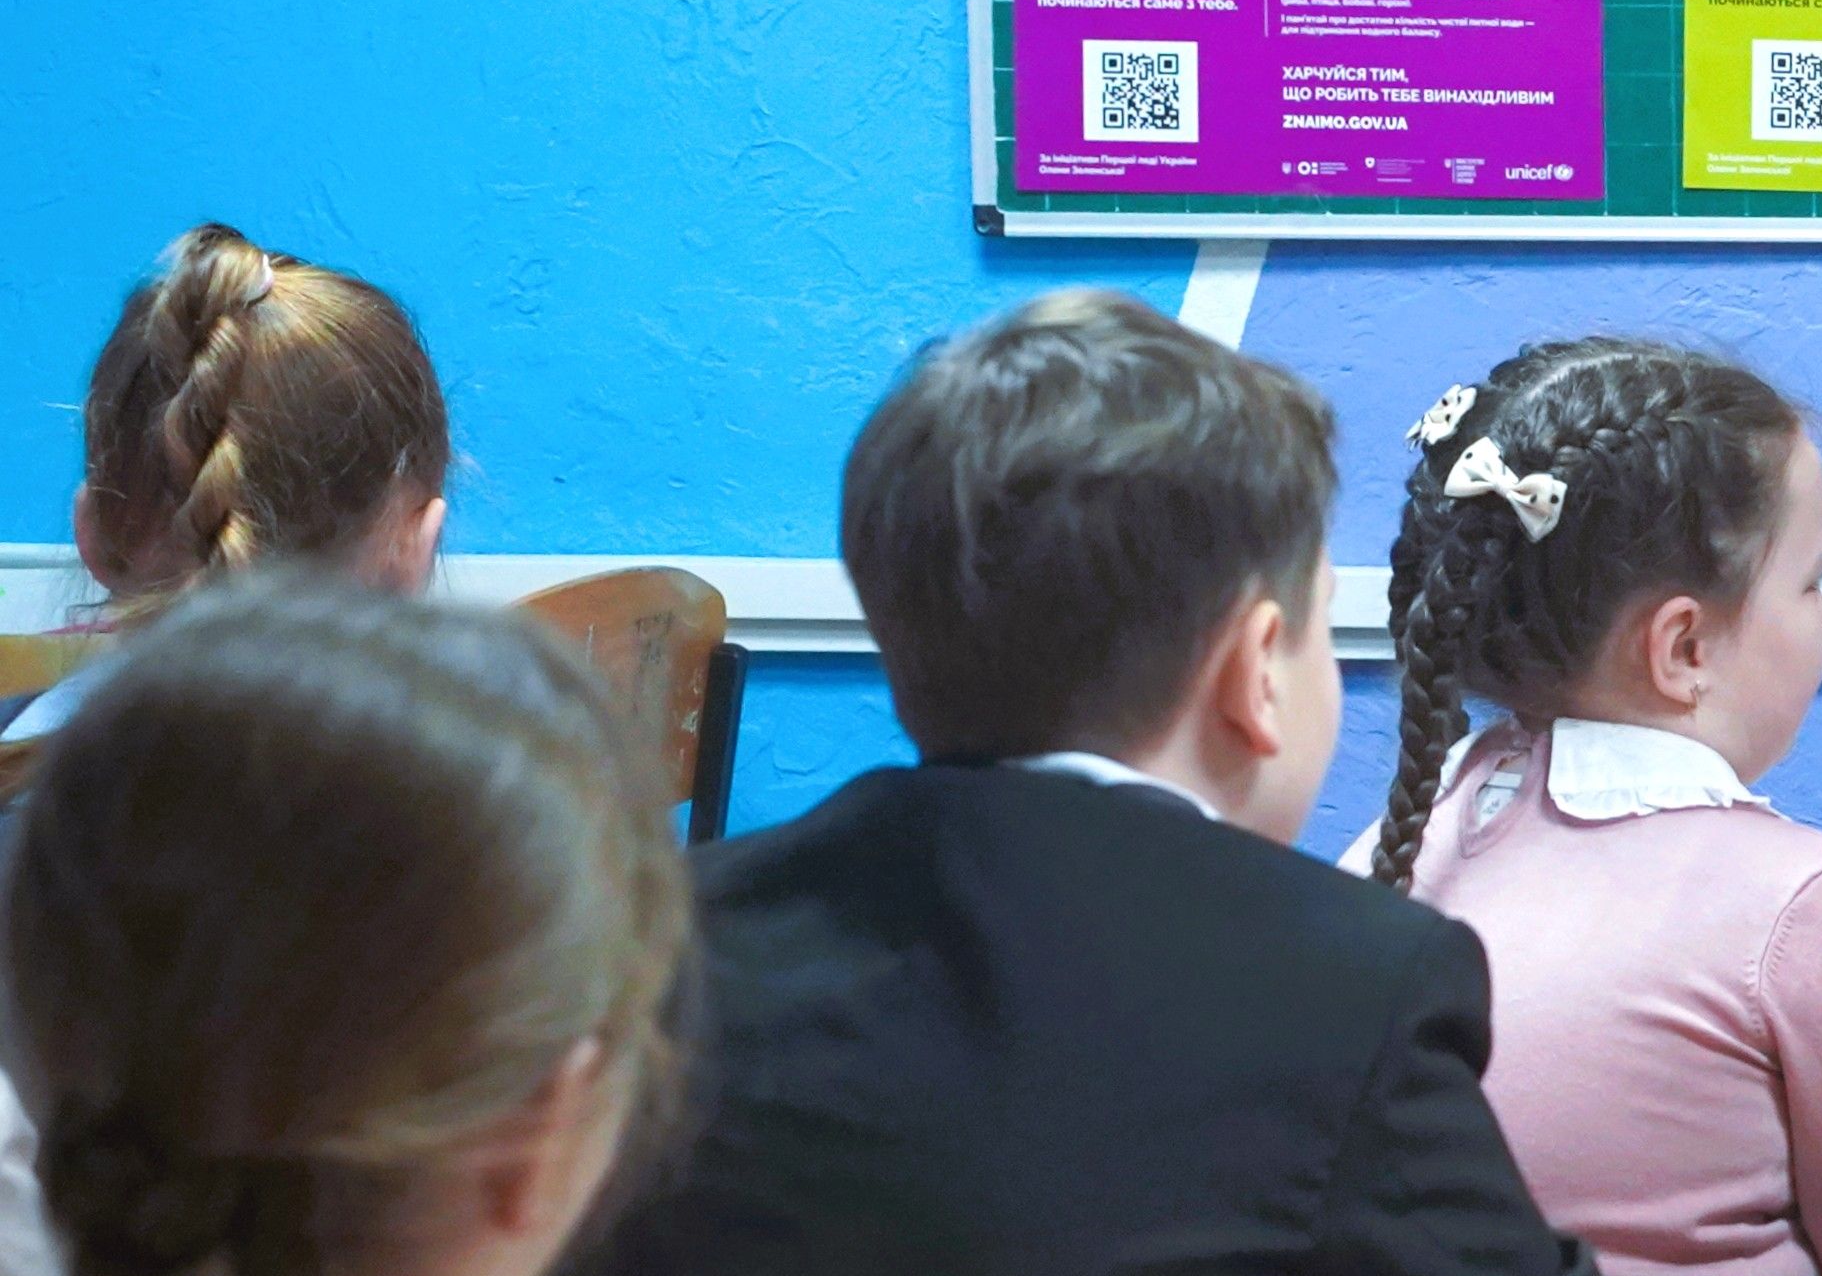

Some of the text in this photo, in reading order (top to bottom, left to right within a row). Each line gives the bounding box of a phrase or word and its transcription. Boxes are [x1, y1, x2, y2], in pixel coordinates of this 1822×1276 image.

[1186, 0, 1194, 9] з
[1283, 64, 1408, 83] ХАРЧУЙСЯ ТИМ,
[1283, 87, 1553, 105] ЩО РОБИТЬ ТЕБЕ ВИНАХІДЛИВИМ
[1283, 115, 1407, 129] ZNAIMO.GOV.UA
[1505, 165, 1554, 180] unicef
